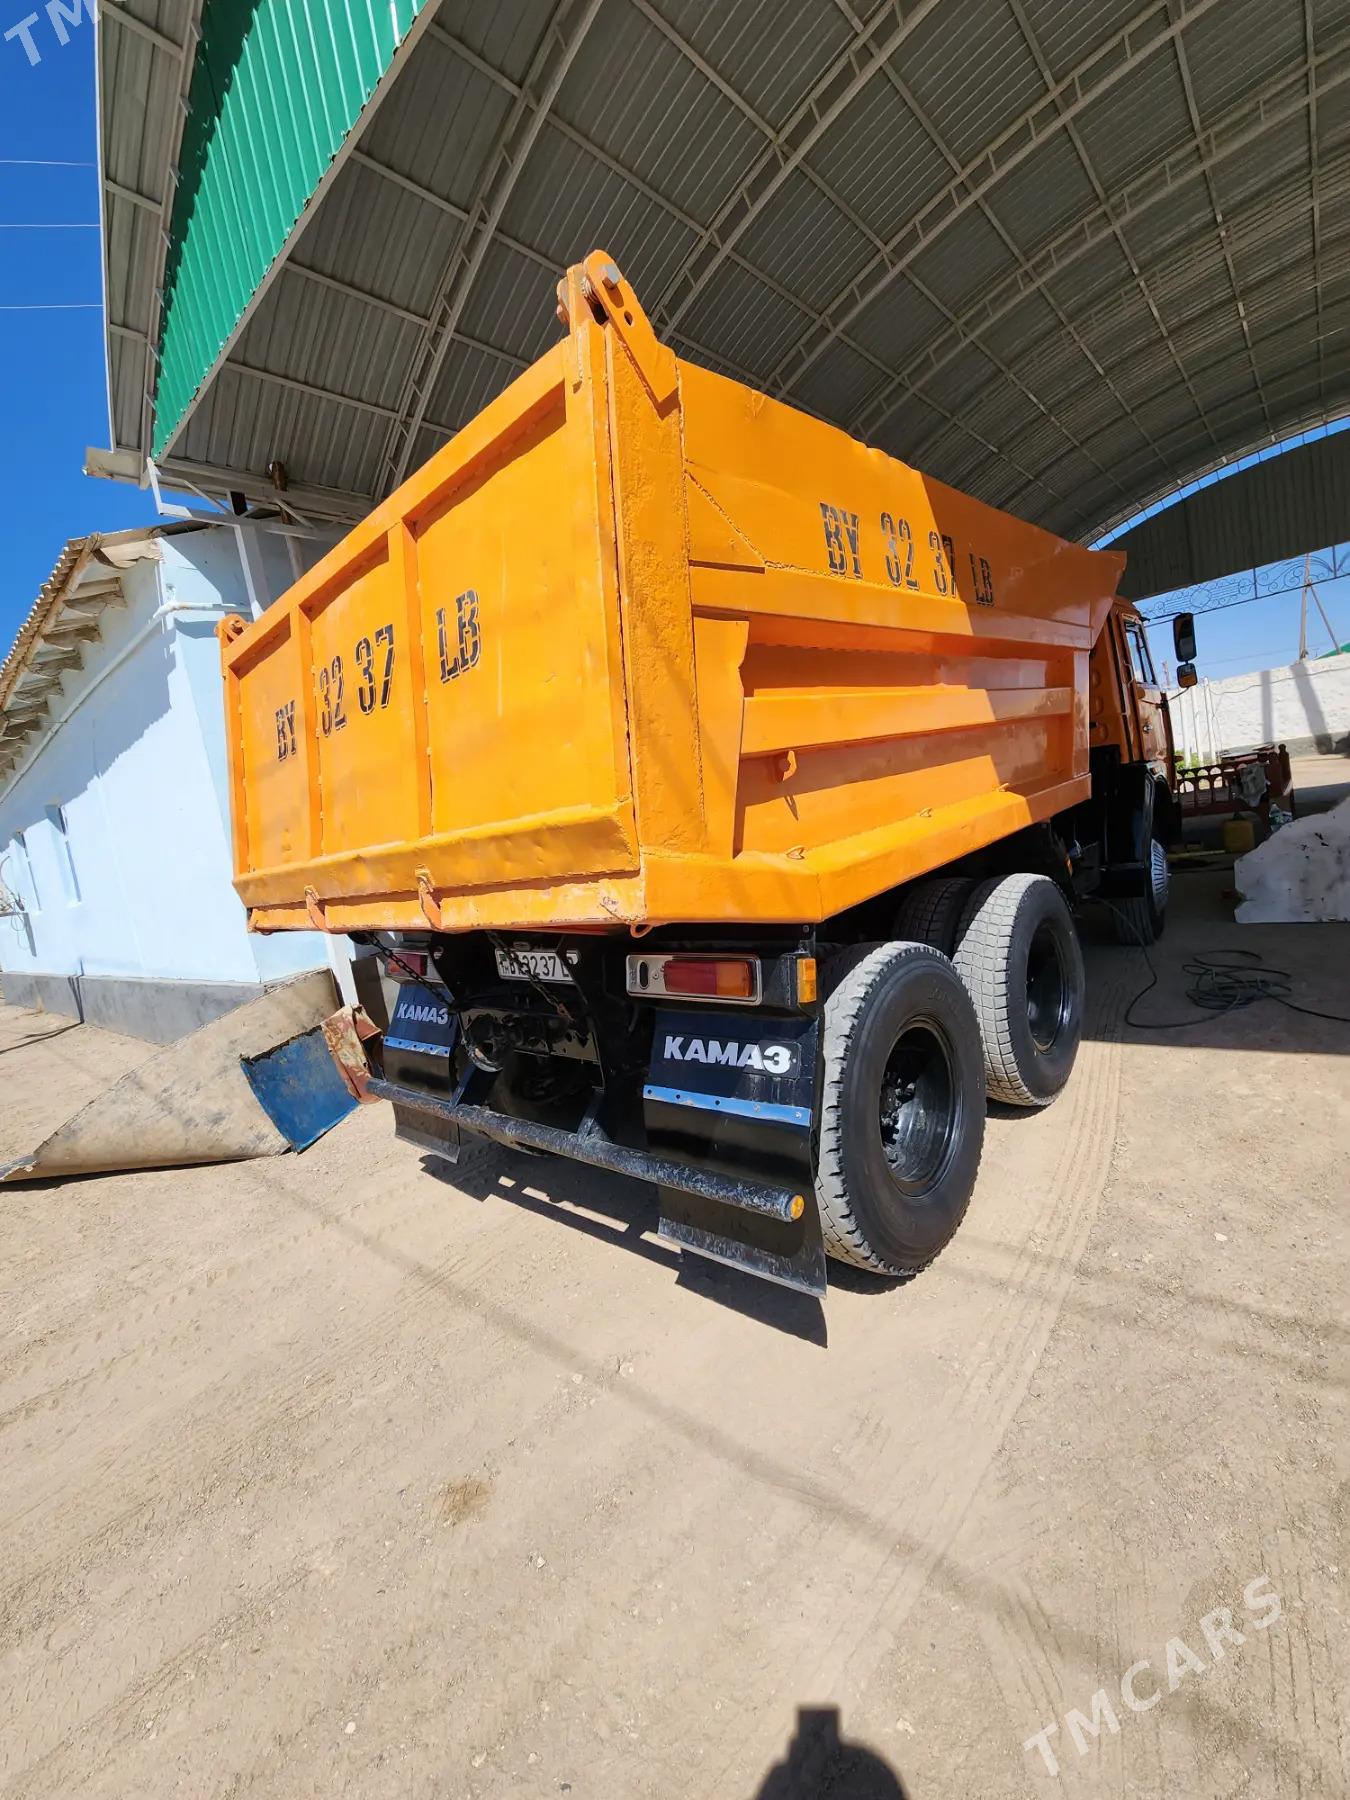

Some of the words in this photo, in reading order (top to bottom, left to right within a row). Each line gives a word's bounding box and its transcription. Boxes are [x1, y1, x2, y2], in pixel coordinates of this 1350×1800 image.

[819, 502, 863, 579] BY
[880, 512, 919, 591] 32
[928, 531, 957, 598] 37
[967, 553, 994, 606] LB
[275, 700, 297, 761] BY
[319, 656, 347, 737] 32
[355, 624, 396, 715] 37
[436, 590, 482, 684] LB
